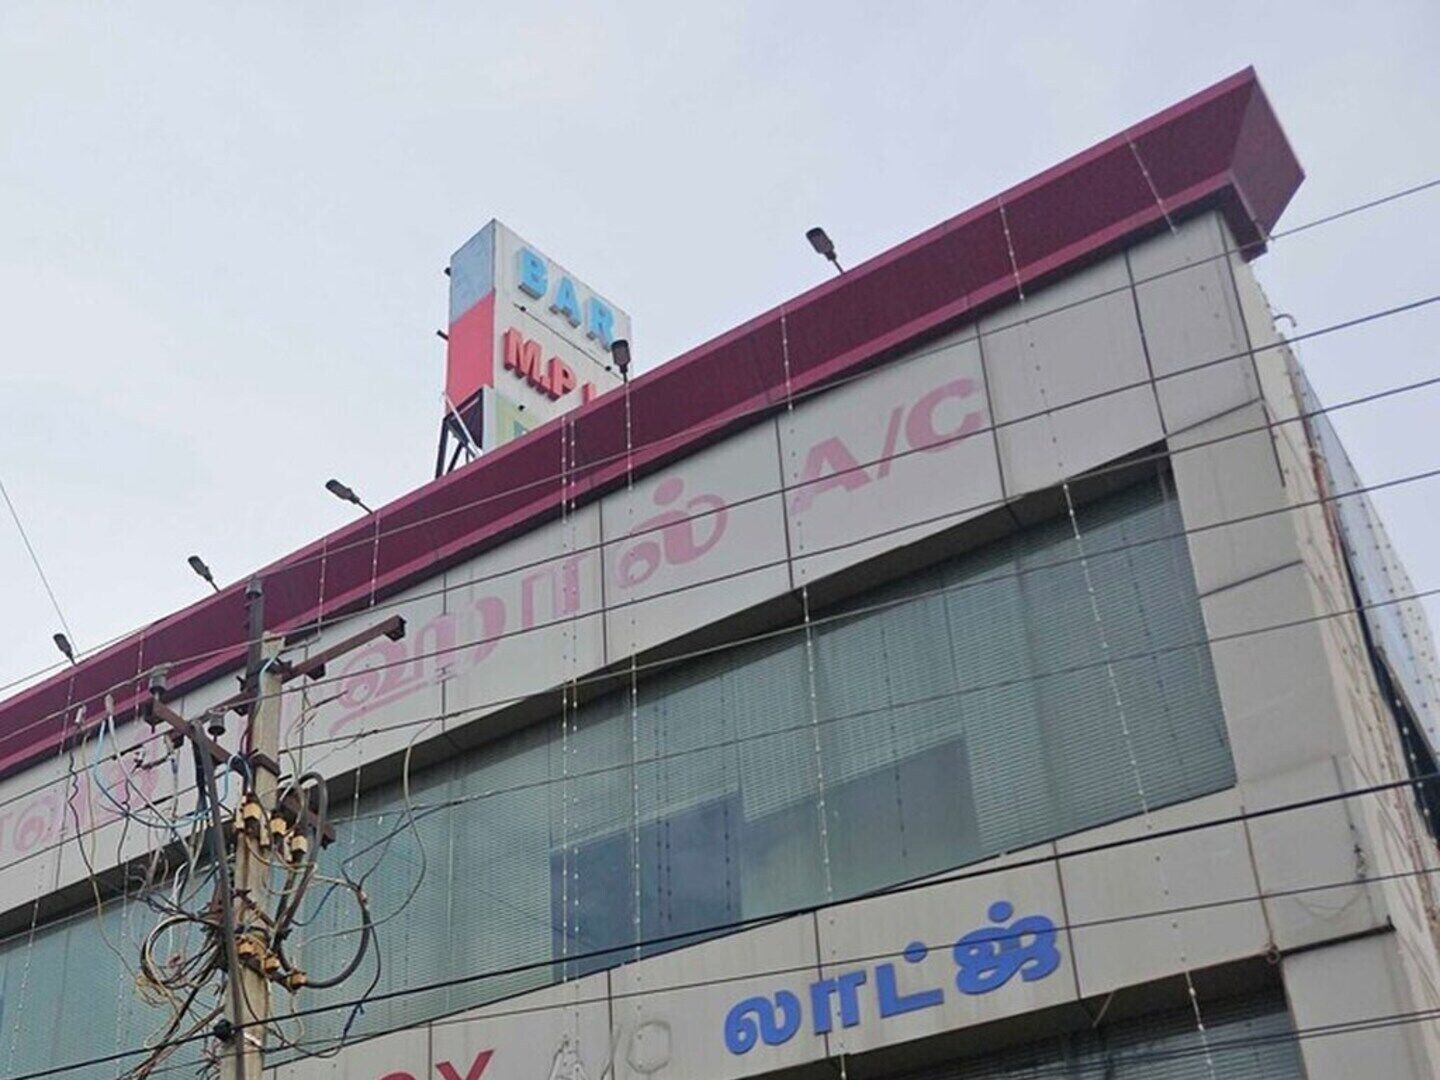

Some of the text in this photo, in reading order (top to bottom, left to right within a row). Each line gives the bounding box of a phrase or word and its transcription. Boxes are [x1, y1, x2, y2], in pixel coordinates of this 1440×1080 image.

[518, 248, 616, 353] BAR
[790, 378, 987, 516] A/C
[723, 900, 1062, 1057] லாட்ஜ்
